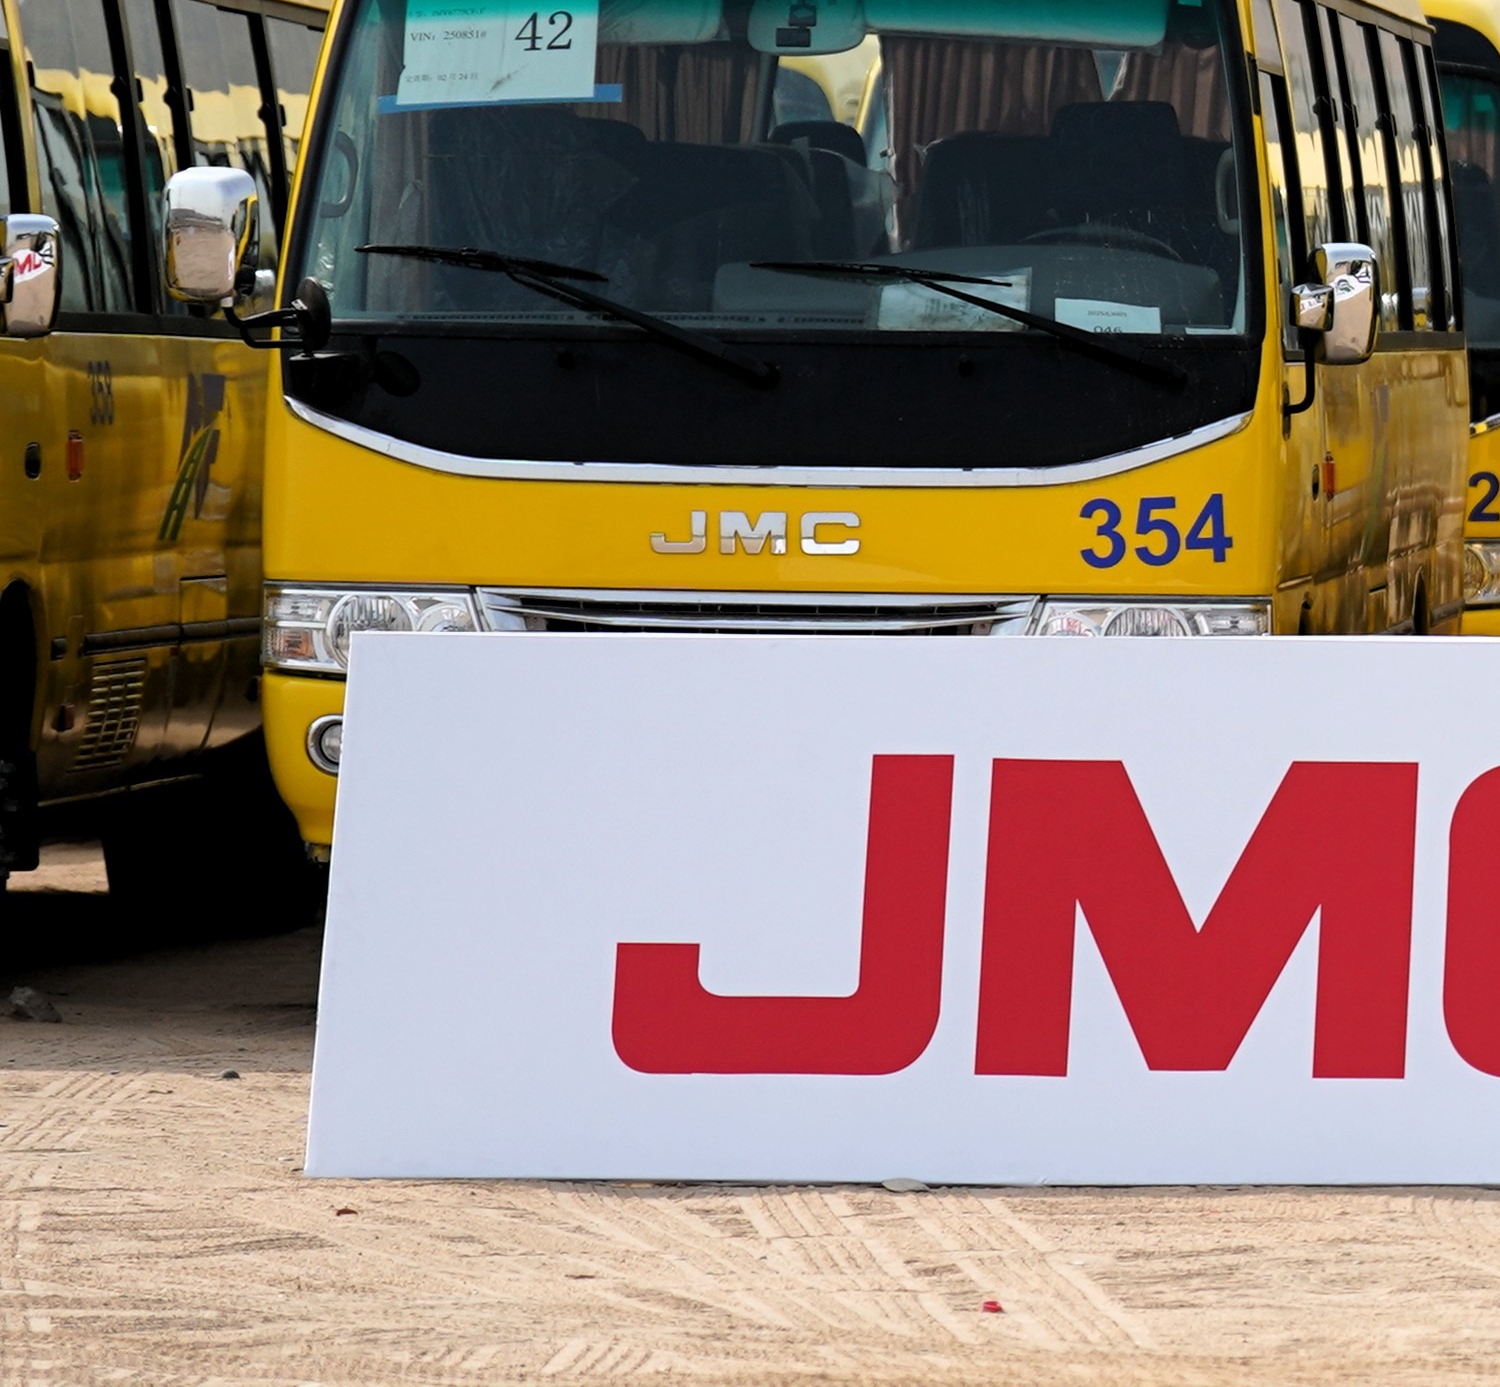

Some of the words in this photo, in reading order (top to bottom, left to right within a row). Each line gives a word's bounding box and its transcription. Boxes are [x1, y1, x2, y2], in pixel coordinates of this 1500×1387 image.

[514, 11, 573, 51] 42
[650, 511, 861, 555] JMC
[1079, 493, 1233, 568] 354
